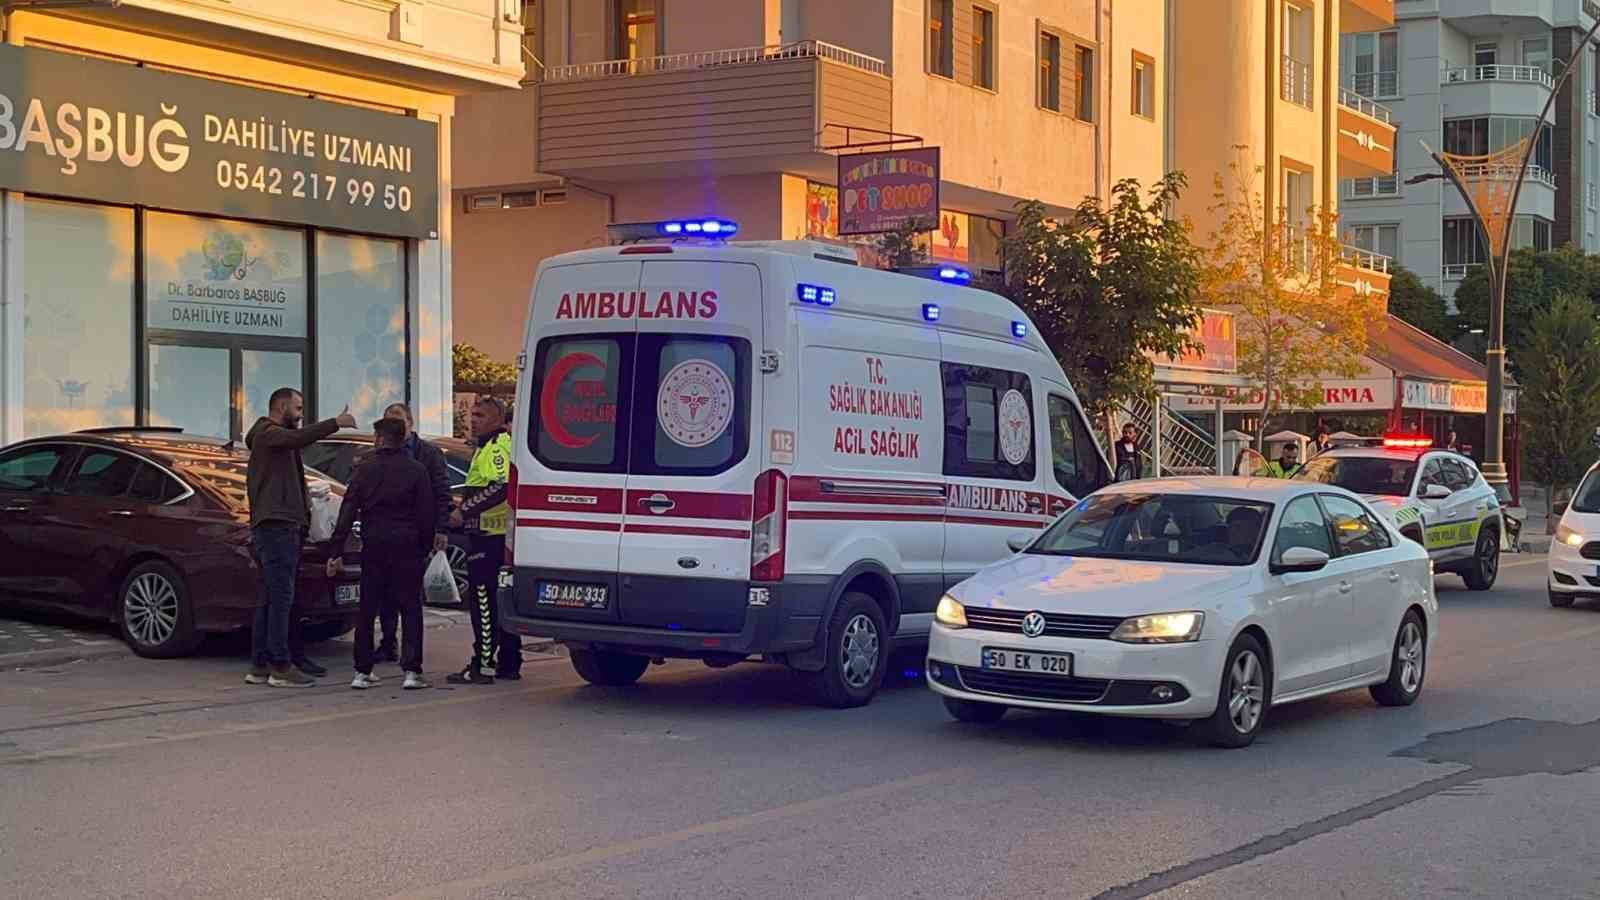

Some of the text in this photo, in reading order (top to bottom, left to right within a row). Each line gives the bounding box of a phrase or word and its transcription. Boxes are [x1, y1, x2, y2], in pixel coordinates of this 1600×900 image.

[204, 114, 412, 172] DAHİLİYE UZMANI
[217, 159, 411, 212] 0542 217 99 50
[168, 281, 287, 305] Dr. Barbaros BAŞBUĞ
[556, 291, 718, 319] AMBULANS
[172, 306, 283, 328] DAHİLİYE UZMANI
[866, 357, 887, 385] T.C.
[830, 381, 922, 420] SAĞLIK BAKANLIĞI
[773, 432, 793, 451] 112
[870, 426, 919, 458] SAĞLIK
[949, 484, 1027, 513] AMBULANS
[545, 584, 606, 602] 50 AAC 333
[990, 651, 1066, 672] 50 EK 020
